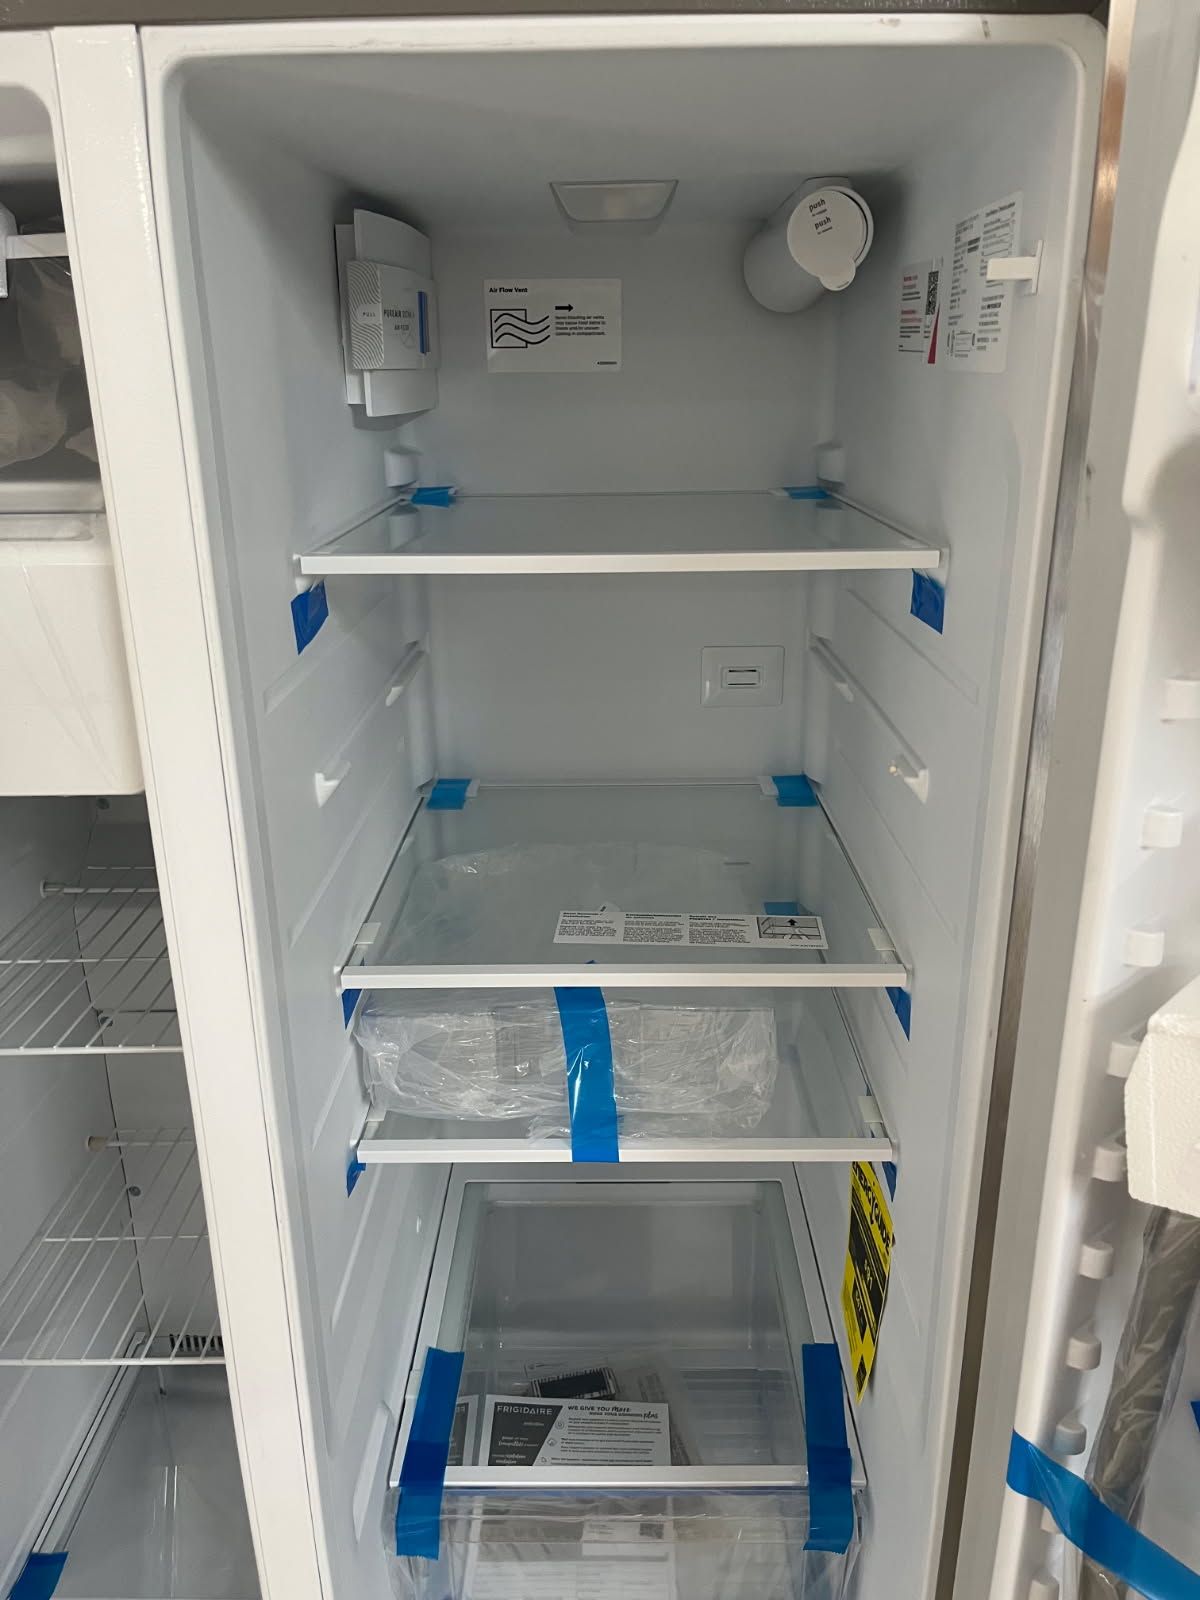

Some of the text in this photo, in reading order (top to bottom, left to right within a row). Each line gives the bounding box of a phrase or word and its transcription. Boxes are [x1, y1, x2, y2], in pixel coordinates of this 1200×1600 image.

[809, 198, 826, 213] push
[814, 216, 831, 230] push
[496, 1405, 553, 1415] FRIGIDAIRE
